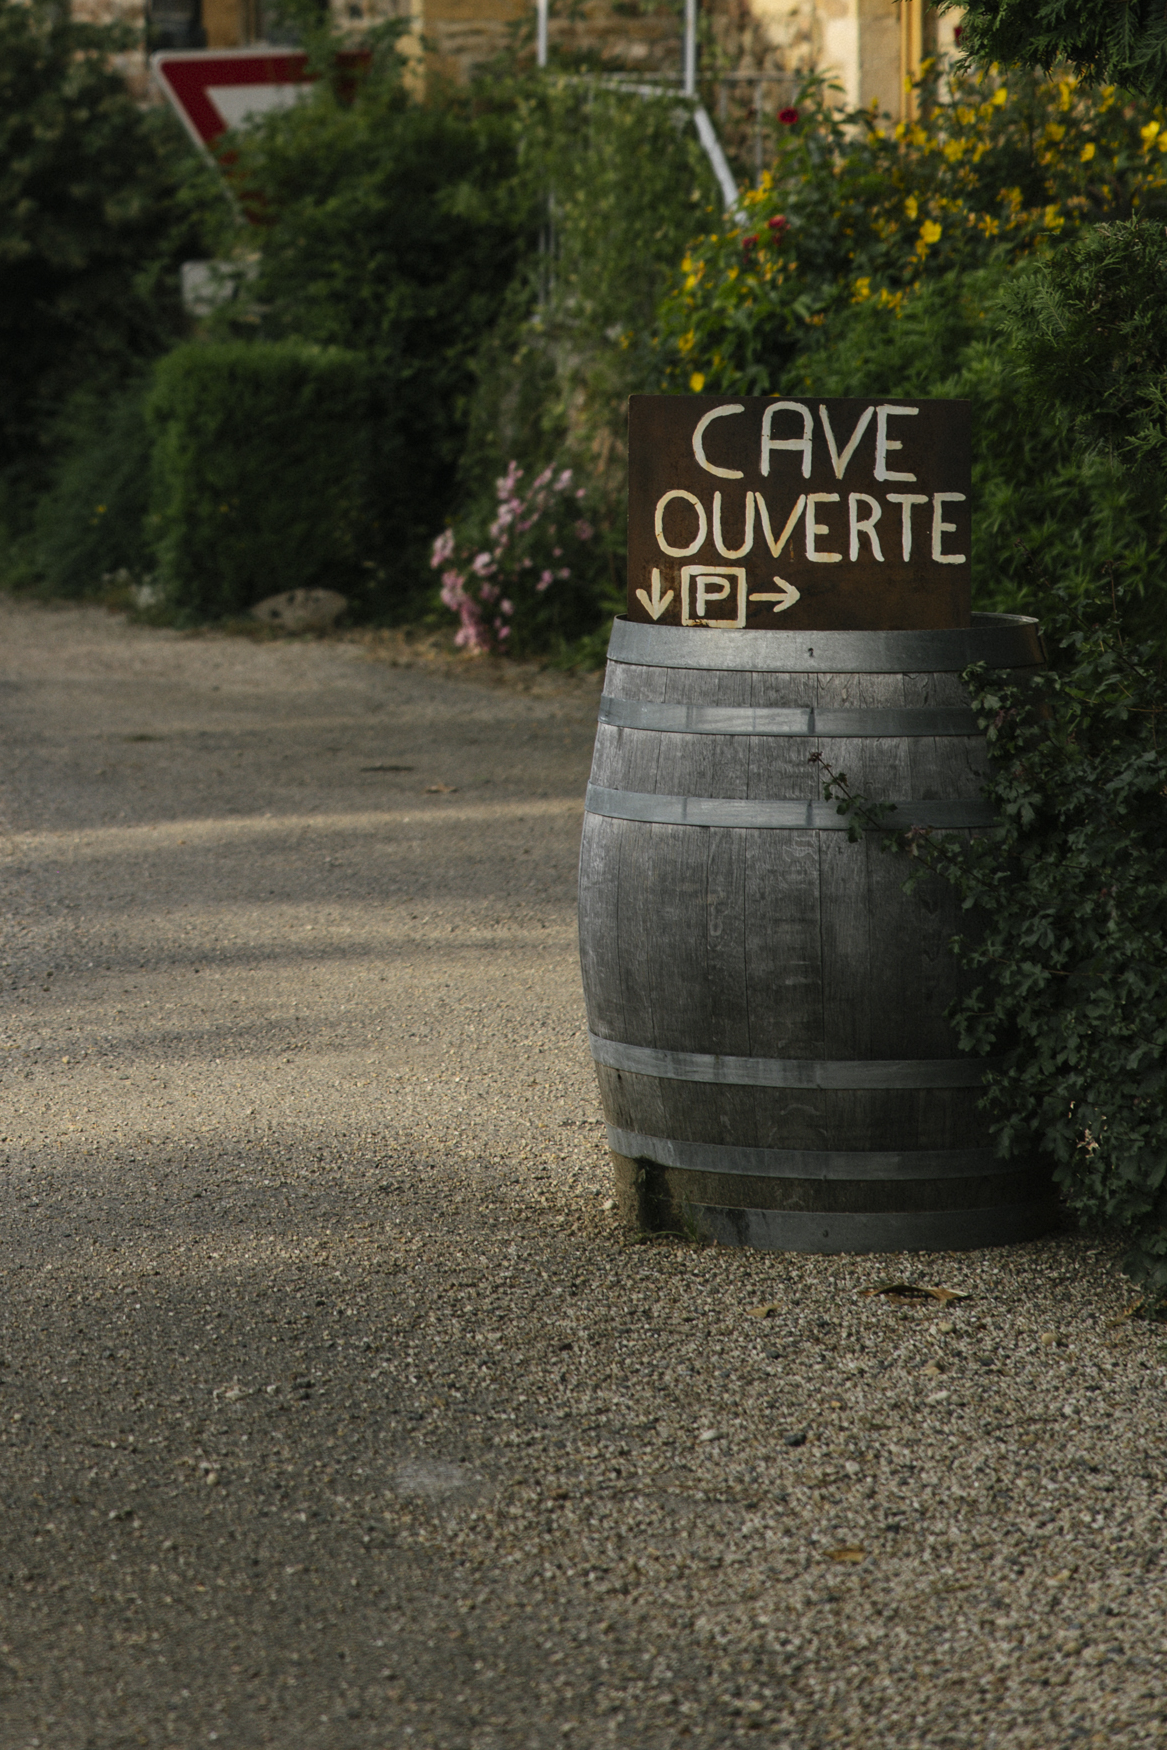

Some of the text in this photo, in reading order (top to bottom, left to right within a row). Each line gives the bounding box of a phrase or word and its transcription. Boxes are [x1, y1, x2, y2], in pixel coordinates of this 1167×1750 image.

[692, 401, 919, 482] CAVE
[654, 489, 966, 564] OUVERTE
[695, 576, 731, 616] P
